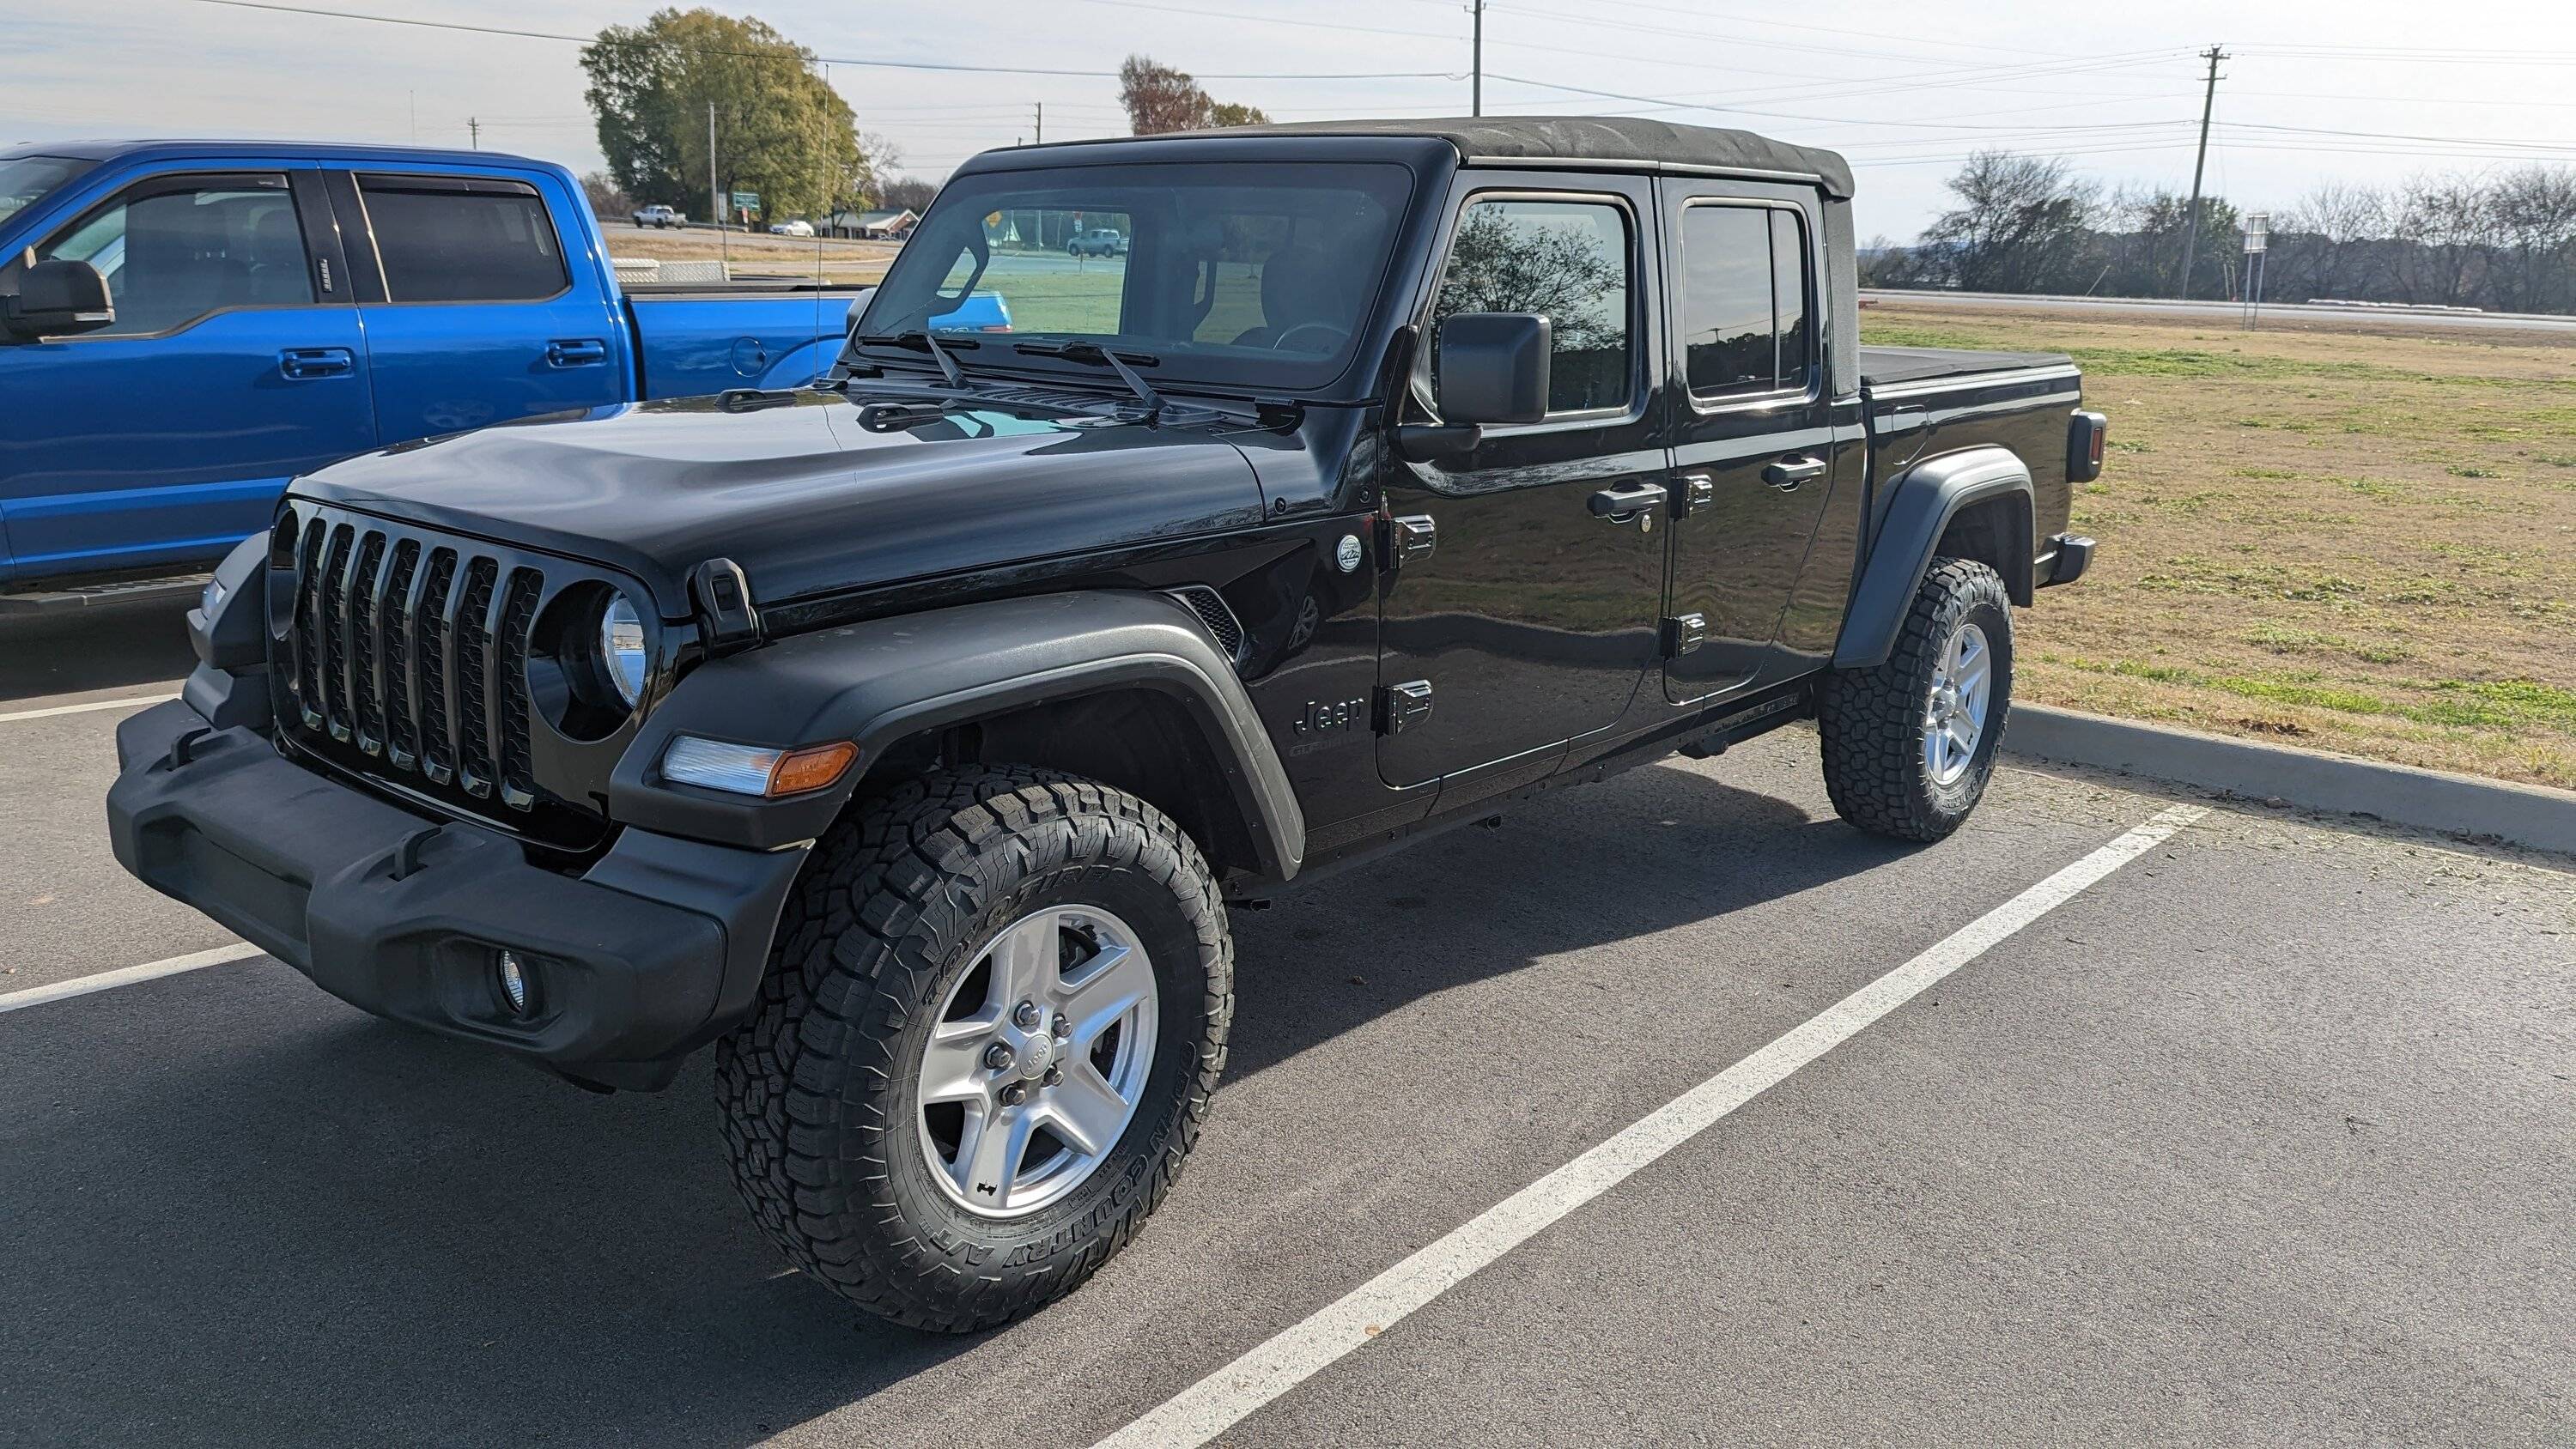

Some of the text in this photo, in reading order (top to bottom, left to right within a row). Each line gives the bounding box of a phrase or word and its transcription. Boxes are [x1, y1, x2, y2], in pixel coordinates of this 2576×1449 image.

[1293, 698, 1364, 736] Jeep
[921, 895, 1012, 1006] TOYO
[1015, 864, 1133, 902] TIRES
[1027, 1042, 1048, 1070] Jeep
[1150, 1040, 1197, 1153] OPEN
[1002, 1154, 1149, 1268] COUNTRY
